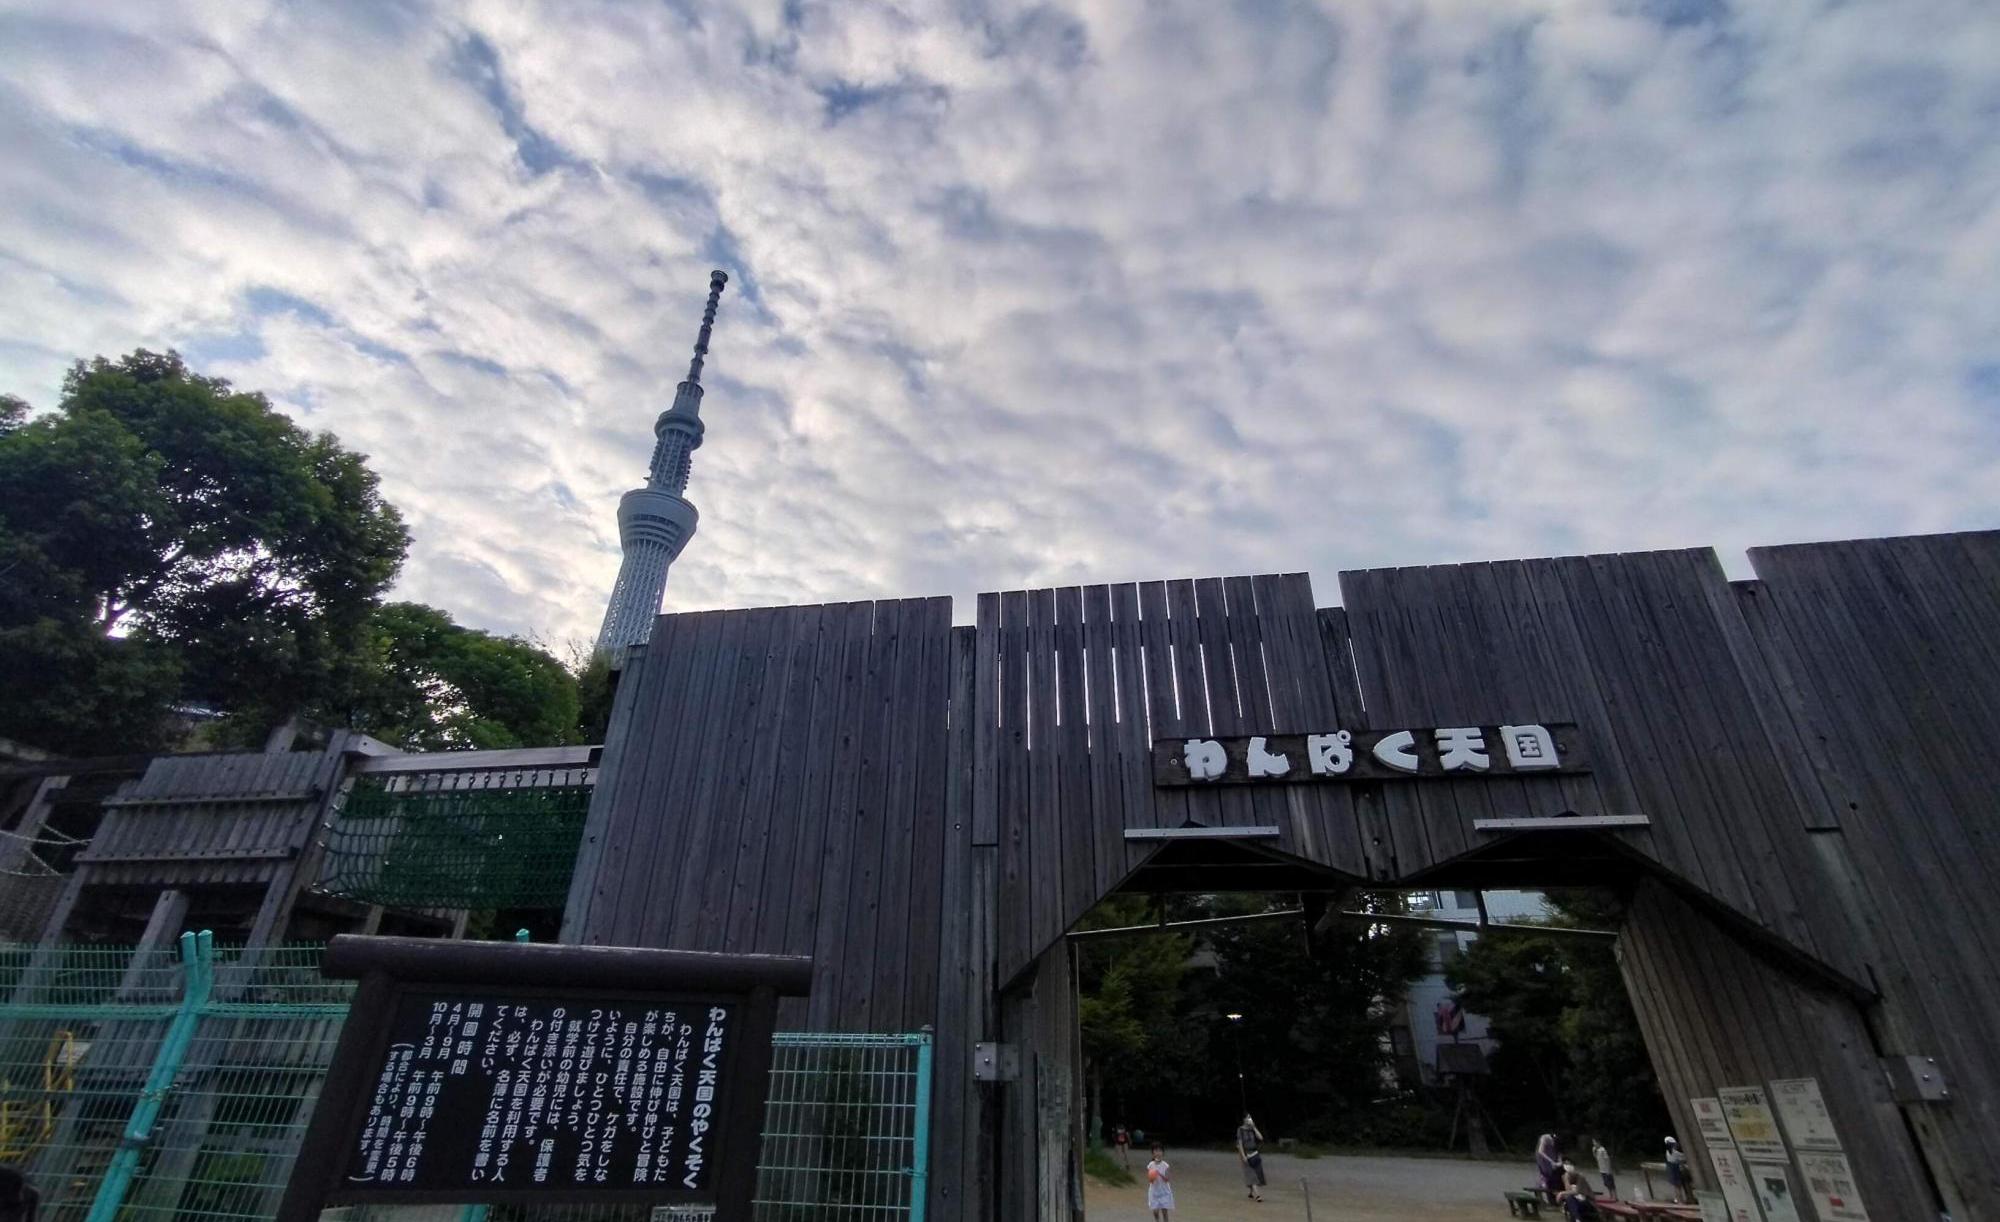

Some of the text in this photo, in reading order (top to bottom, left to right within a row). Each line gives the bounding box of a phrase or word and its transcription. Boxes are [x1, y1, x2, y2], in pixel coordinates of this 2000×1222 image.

[1184, 725, 1560, 781] わんぱく天国
[451, 1004, 483, 1075] 開園時間
[472, 1006, 527, 1180] は、必ず、名簿に名前を書い
[482, 1006, 509, 1074] てください。
[525, 1008, 565, 1144] の付き添いが必要です。
[534, 1020, 582, 1181] 就学前の幼児には、保護者
[568, 1010, 602, 1131] つけて遊びましょう。
[575, 1011, 620, 1181] いように、ひとつひとつ気を
[594, 1022, 637, 1181] 自分の責任で、ケガをしな
[626, 1011, 658, 1131] が楽しめる施設です。
[634, 1012, 675, 1181] ちが、自由に伸び伸びと冒険
